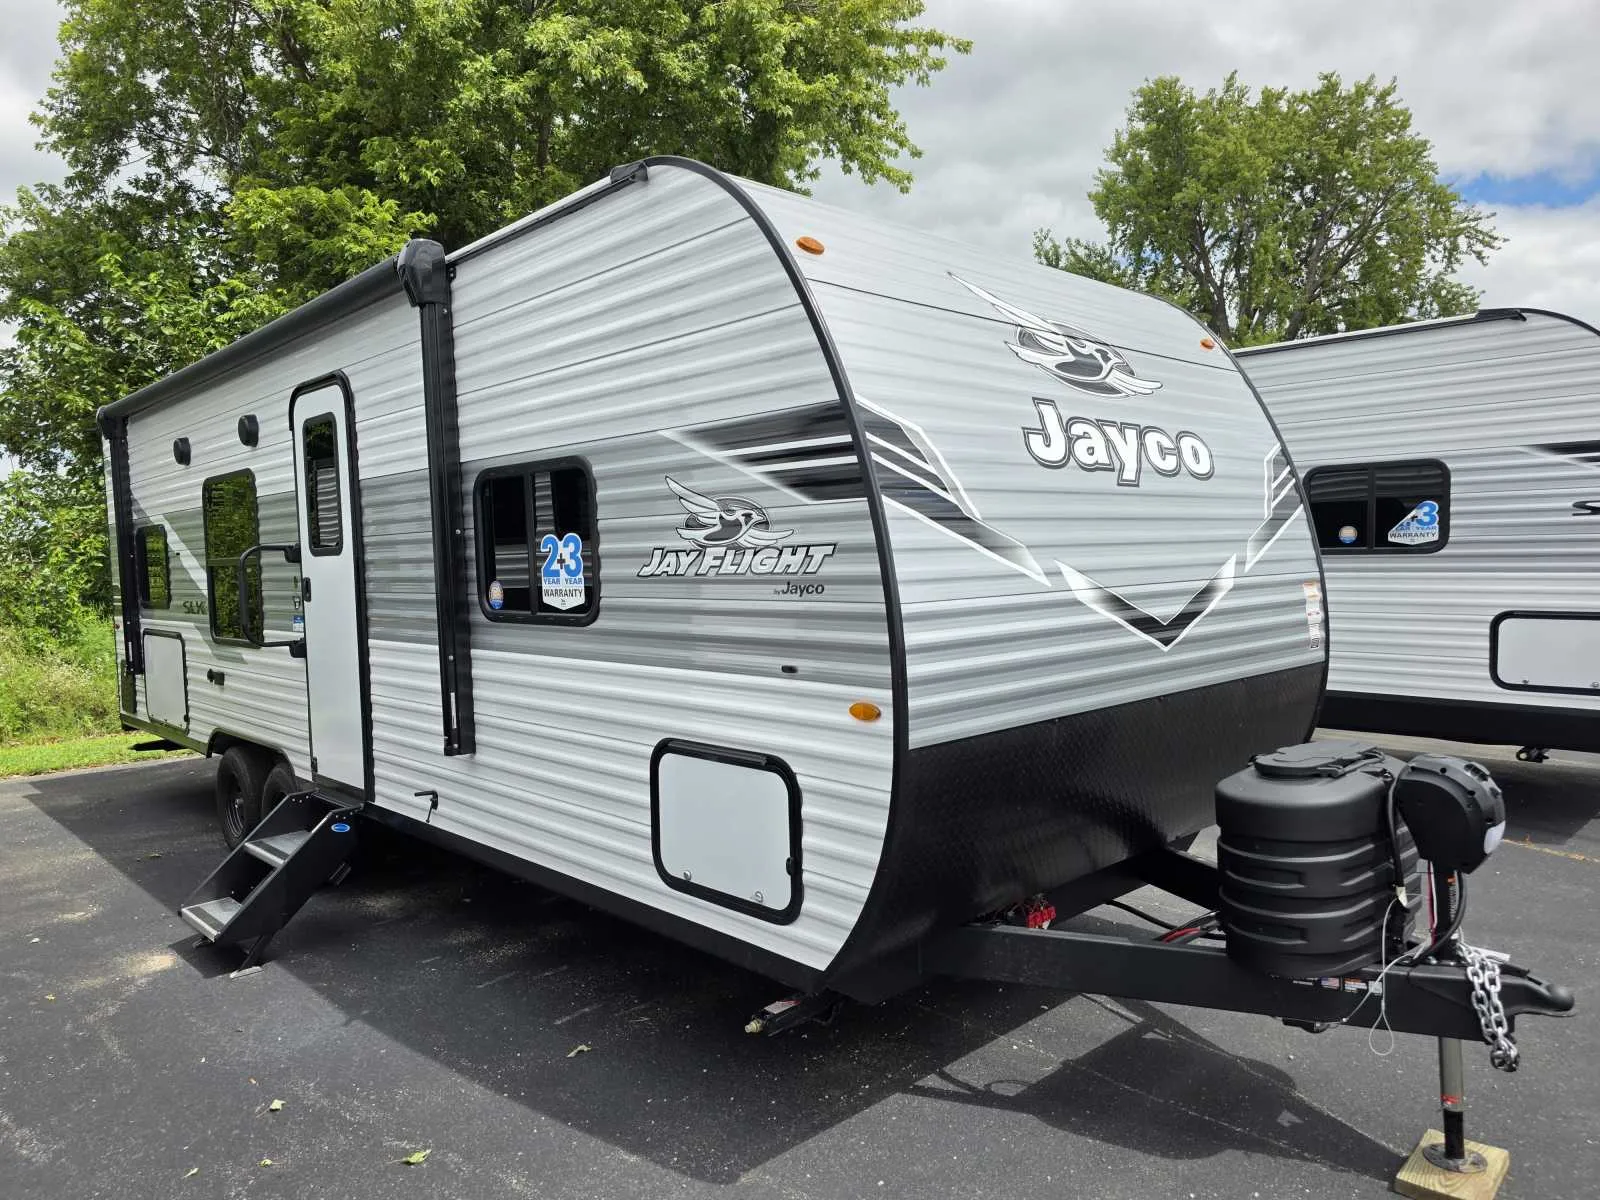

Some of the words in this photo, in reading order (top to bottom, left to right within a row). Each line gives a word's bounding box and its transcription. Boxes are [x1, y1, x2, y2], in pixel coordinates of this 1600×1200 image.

[1020, 396, 1215, 487] Jayco
[637, 547, 704, 577] JAY
[696, 543, 837, 576] FLIGHT
[544, 577, 561, 585] YEAR
[564, 577, 583, 585] YEAR
[782, 581, 825, 597] Jayco
[543, 588, 584, 598] WARRANTY
